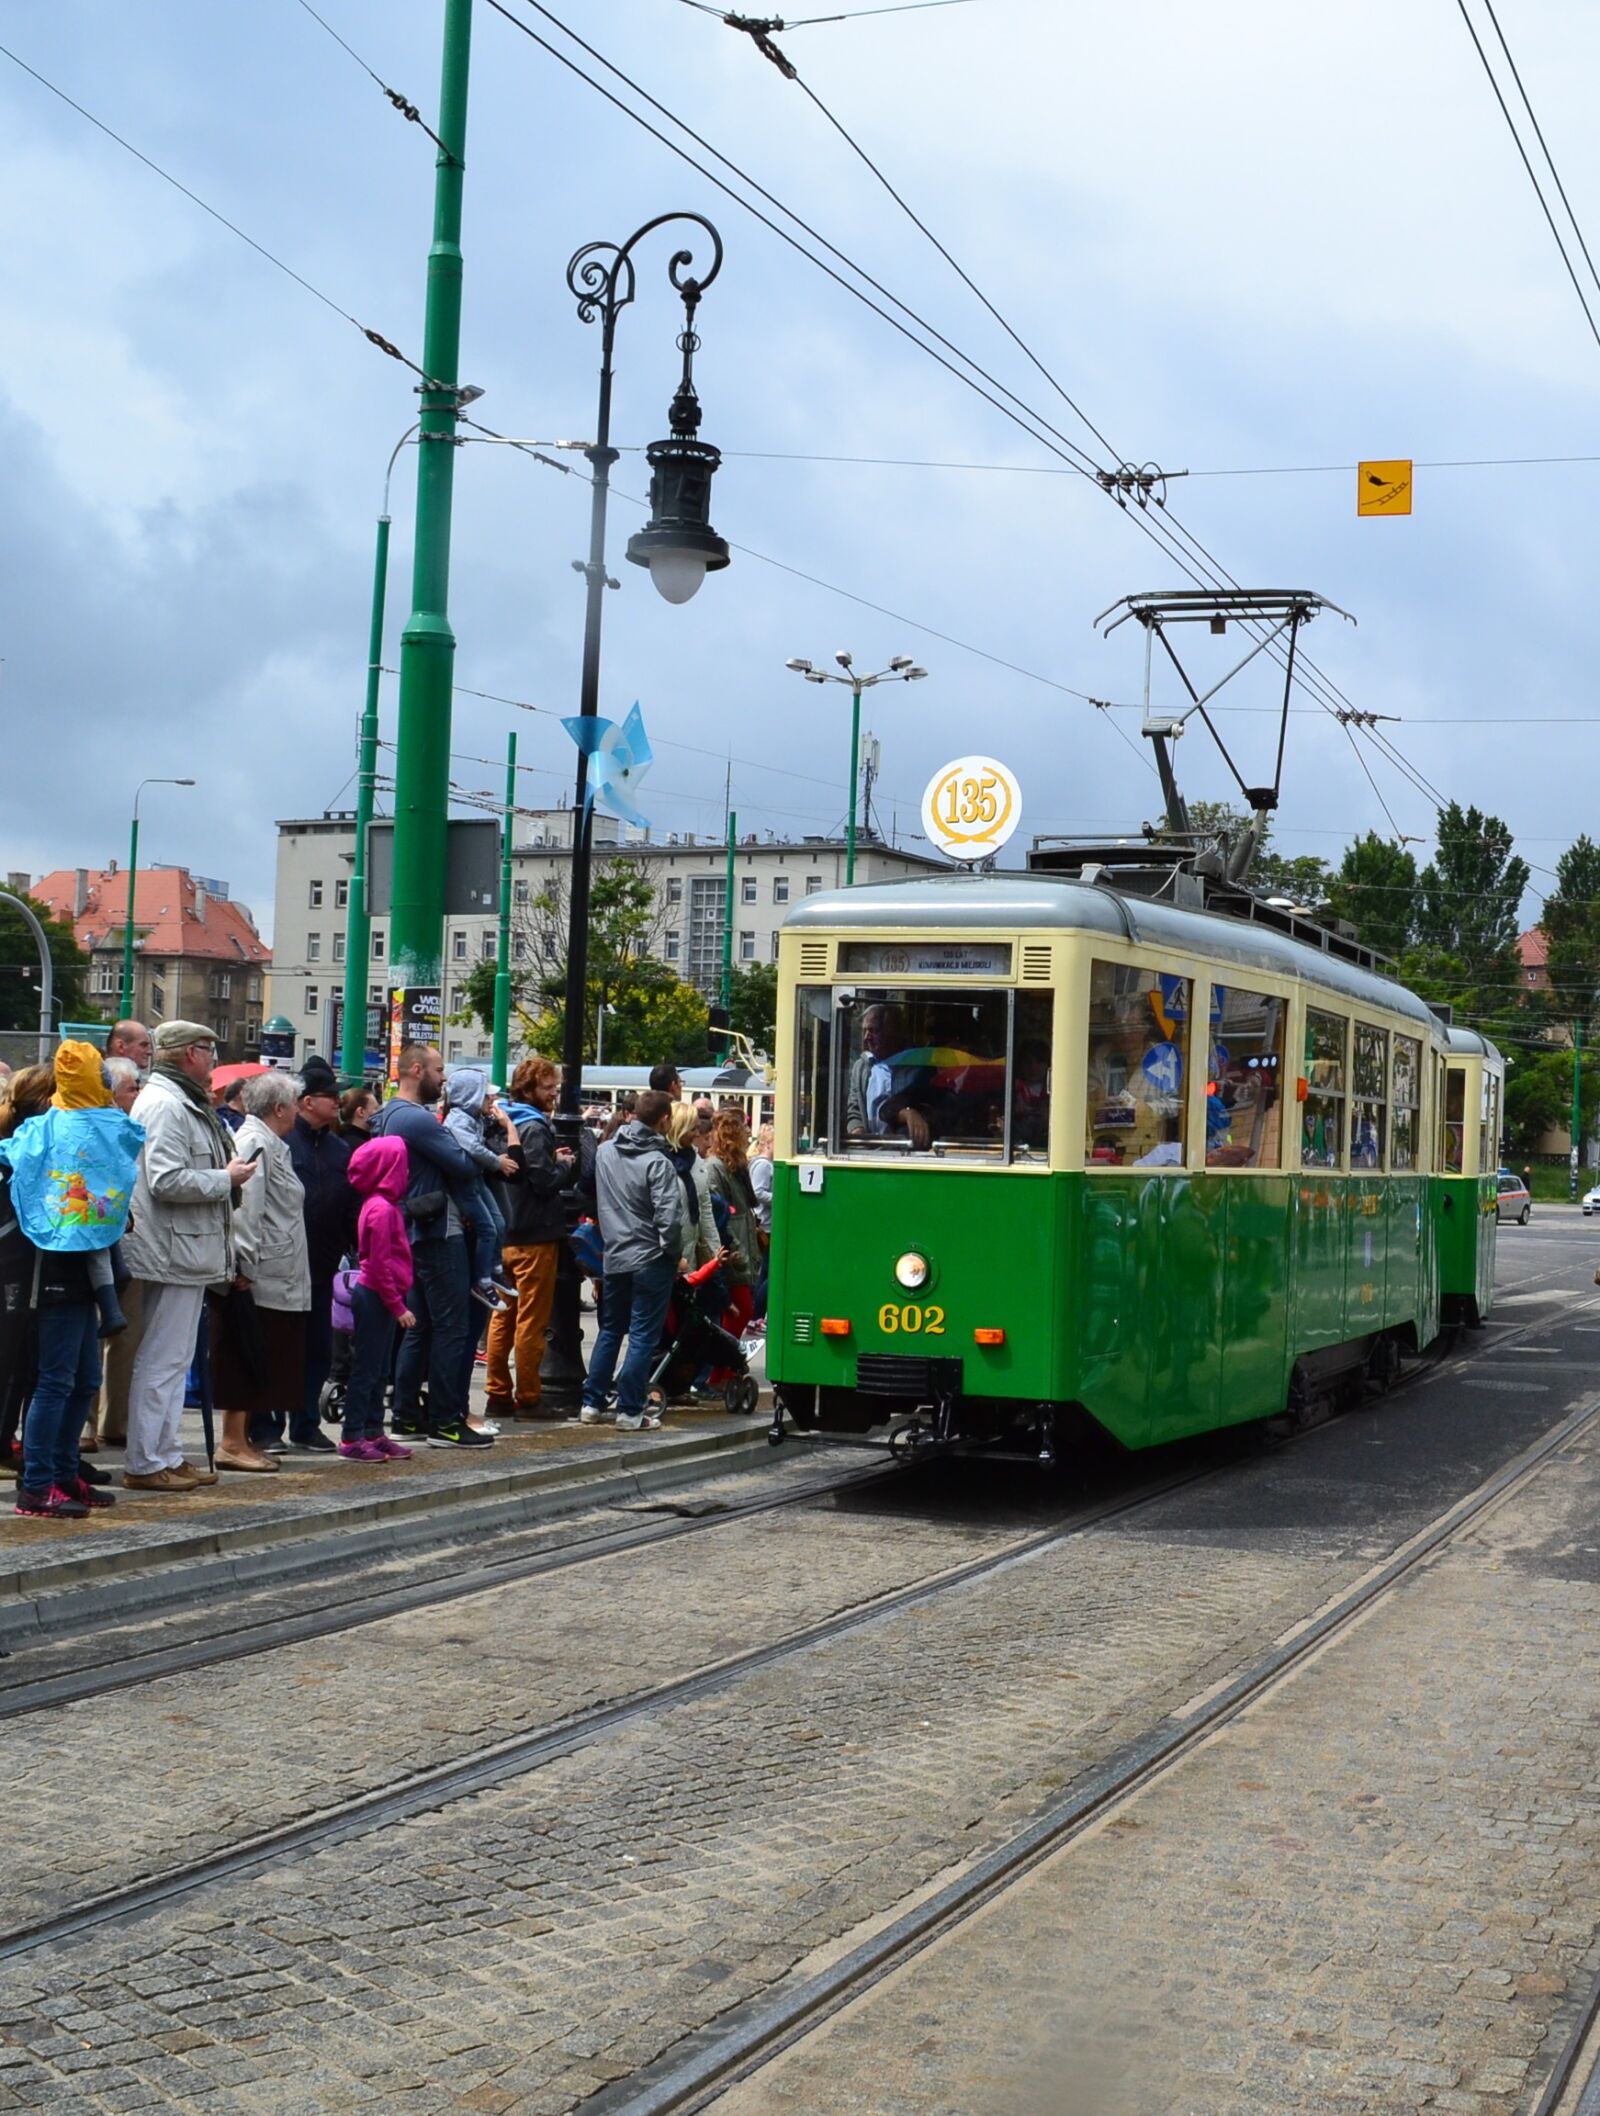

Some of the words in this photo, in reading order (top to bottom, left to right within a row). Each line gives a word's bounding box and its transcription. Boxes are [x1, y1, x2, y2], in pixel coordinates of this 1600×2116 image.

[945, 778, 997, 823] 135
[807, 1170, 815, 1186] 1
[878, 1303, 945, 1334] 602
